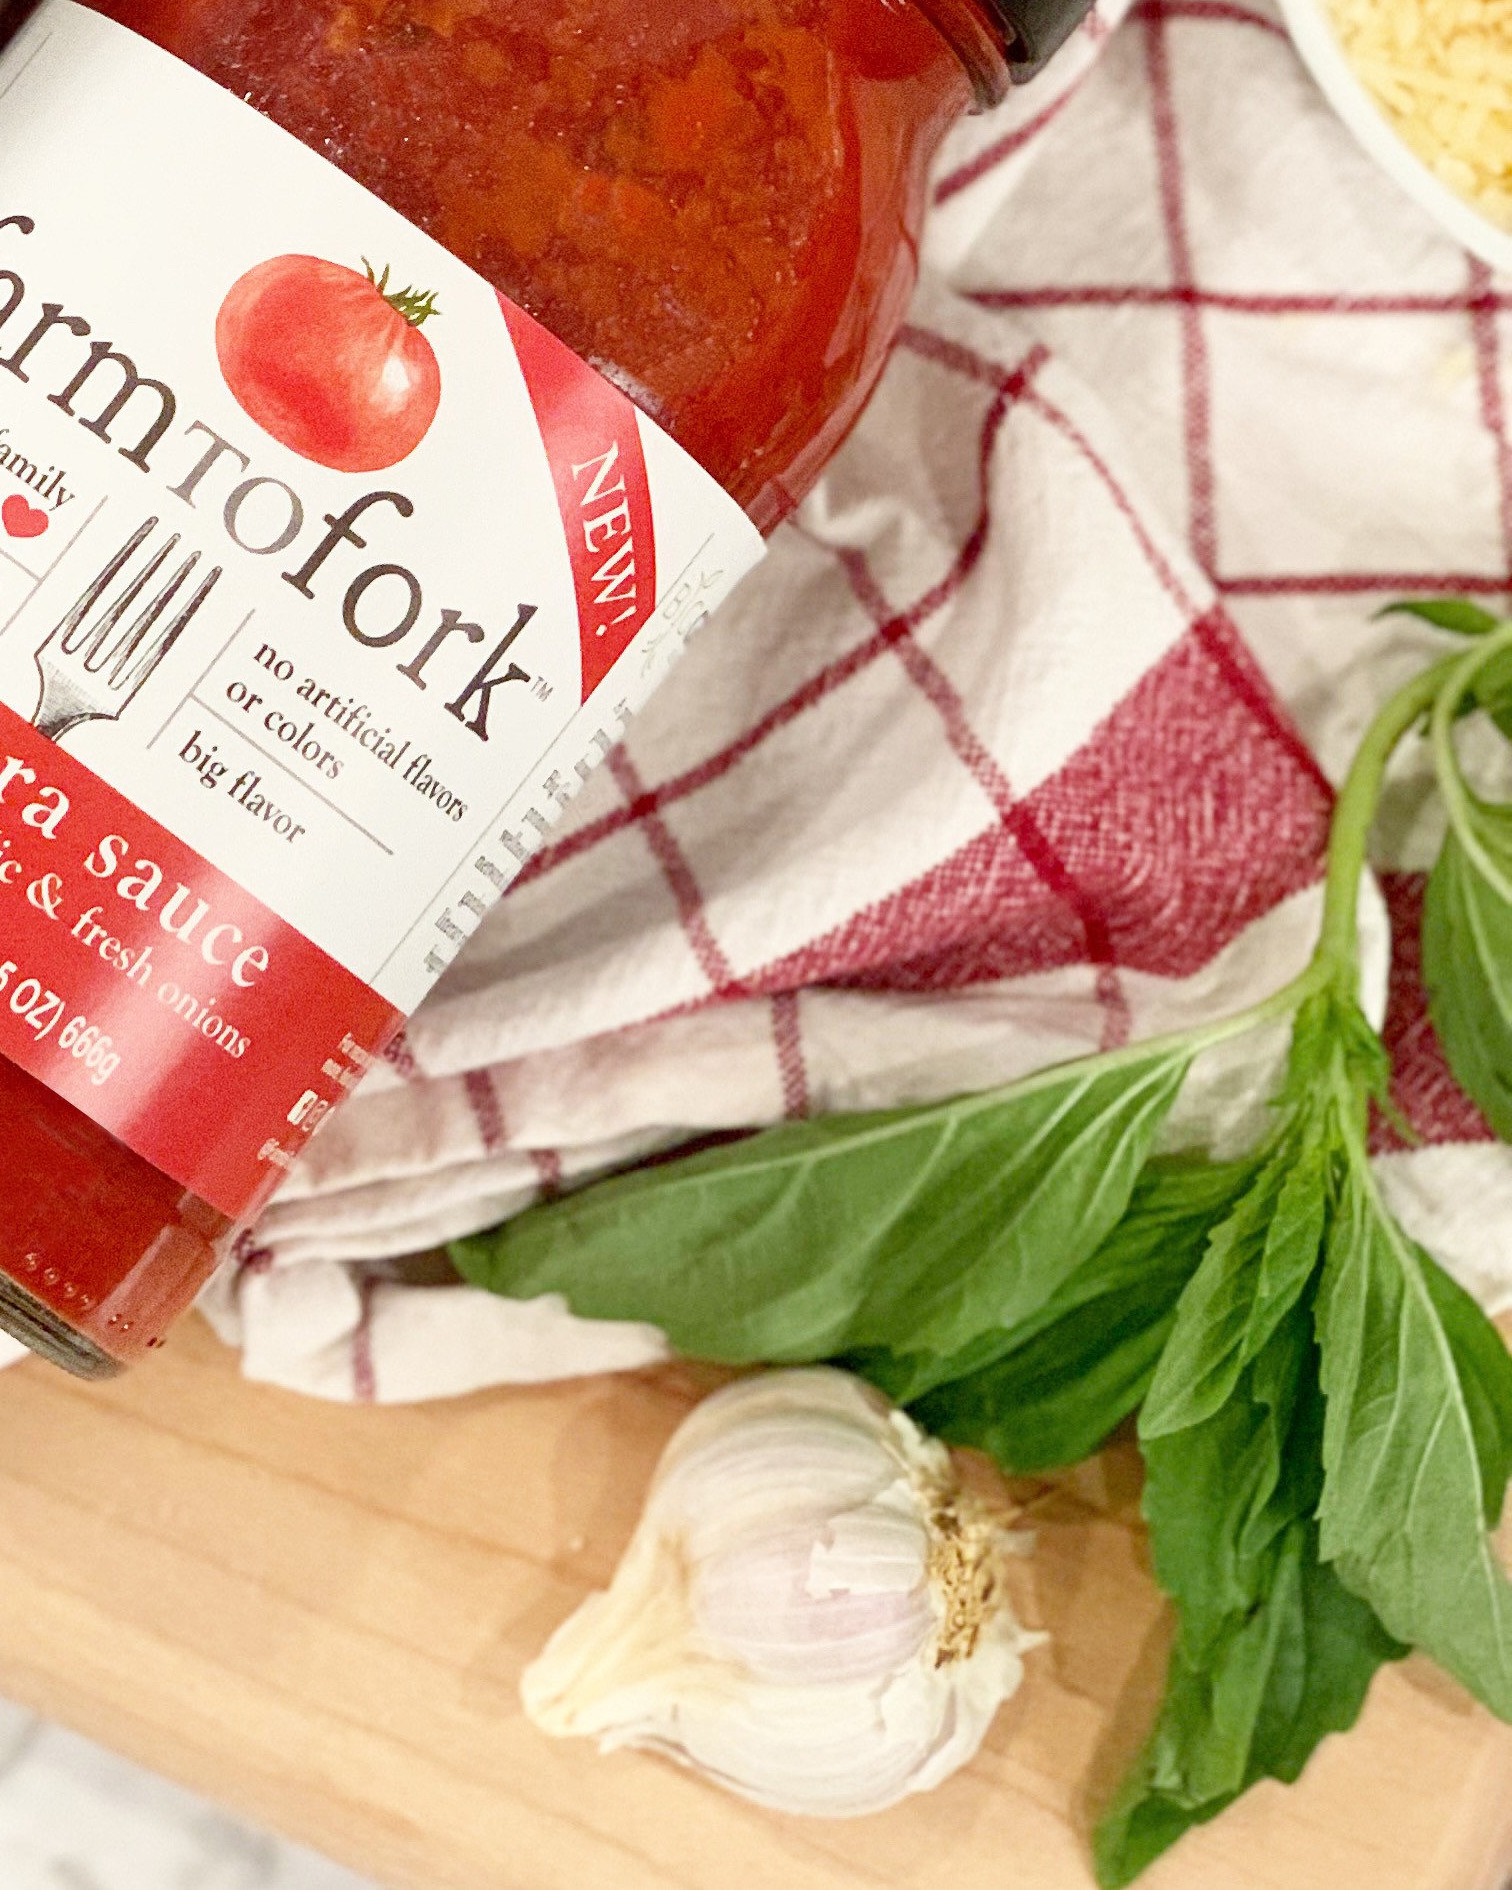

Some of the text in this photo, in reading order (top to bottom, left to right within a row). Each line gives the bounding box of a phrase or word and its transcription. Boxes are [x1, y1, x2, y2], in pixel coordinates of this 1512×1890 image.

[571, 439, 637, 637] NEW!
[179, 731, 305, 842] big flavor
[227, 682, 344, 778] or colors
[254, 644, 467, 821] no artificial flavors
[27, 873, 62, 919] &
[71, 907, 152, 987] fresh
[158, 984, 251, 1058] onions
[83, 835, 268, 987] sauce
[10, 979, 65, 1040] OZ)
[58, 1016, 120, 1086] 666g
